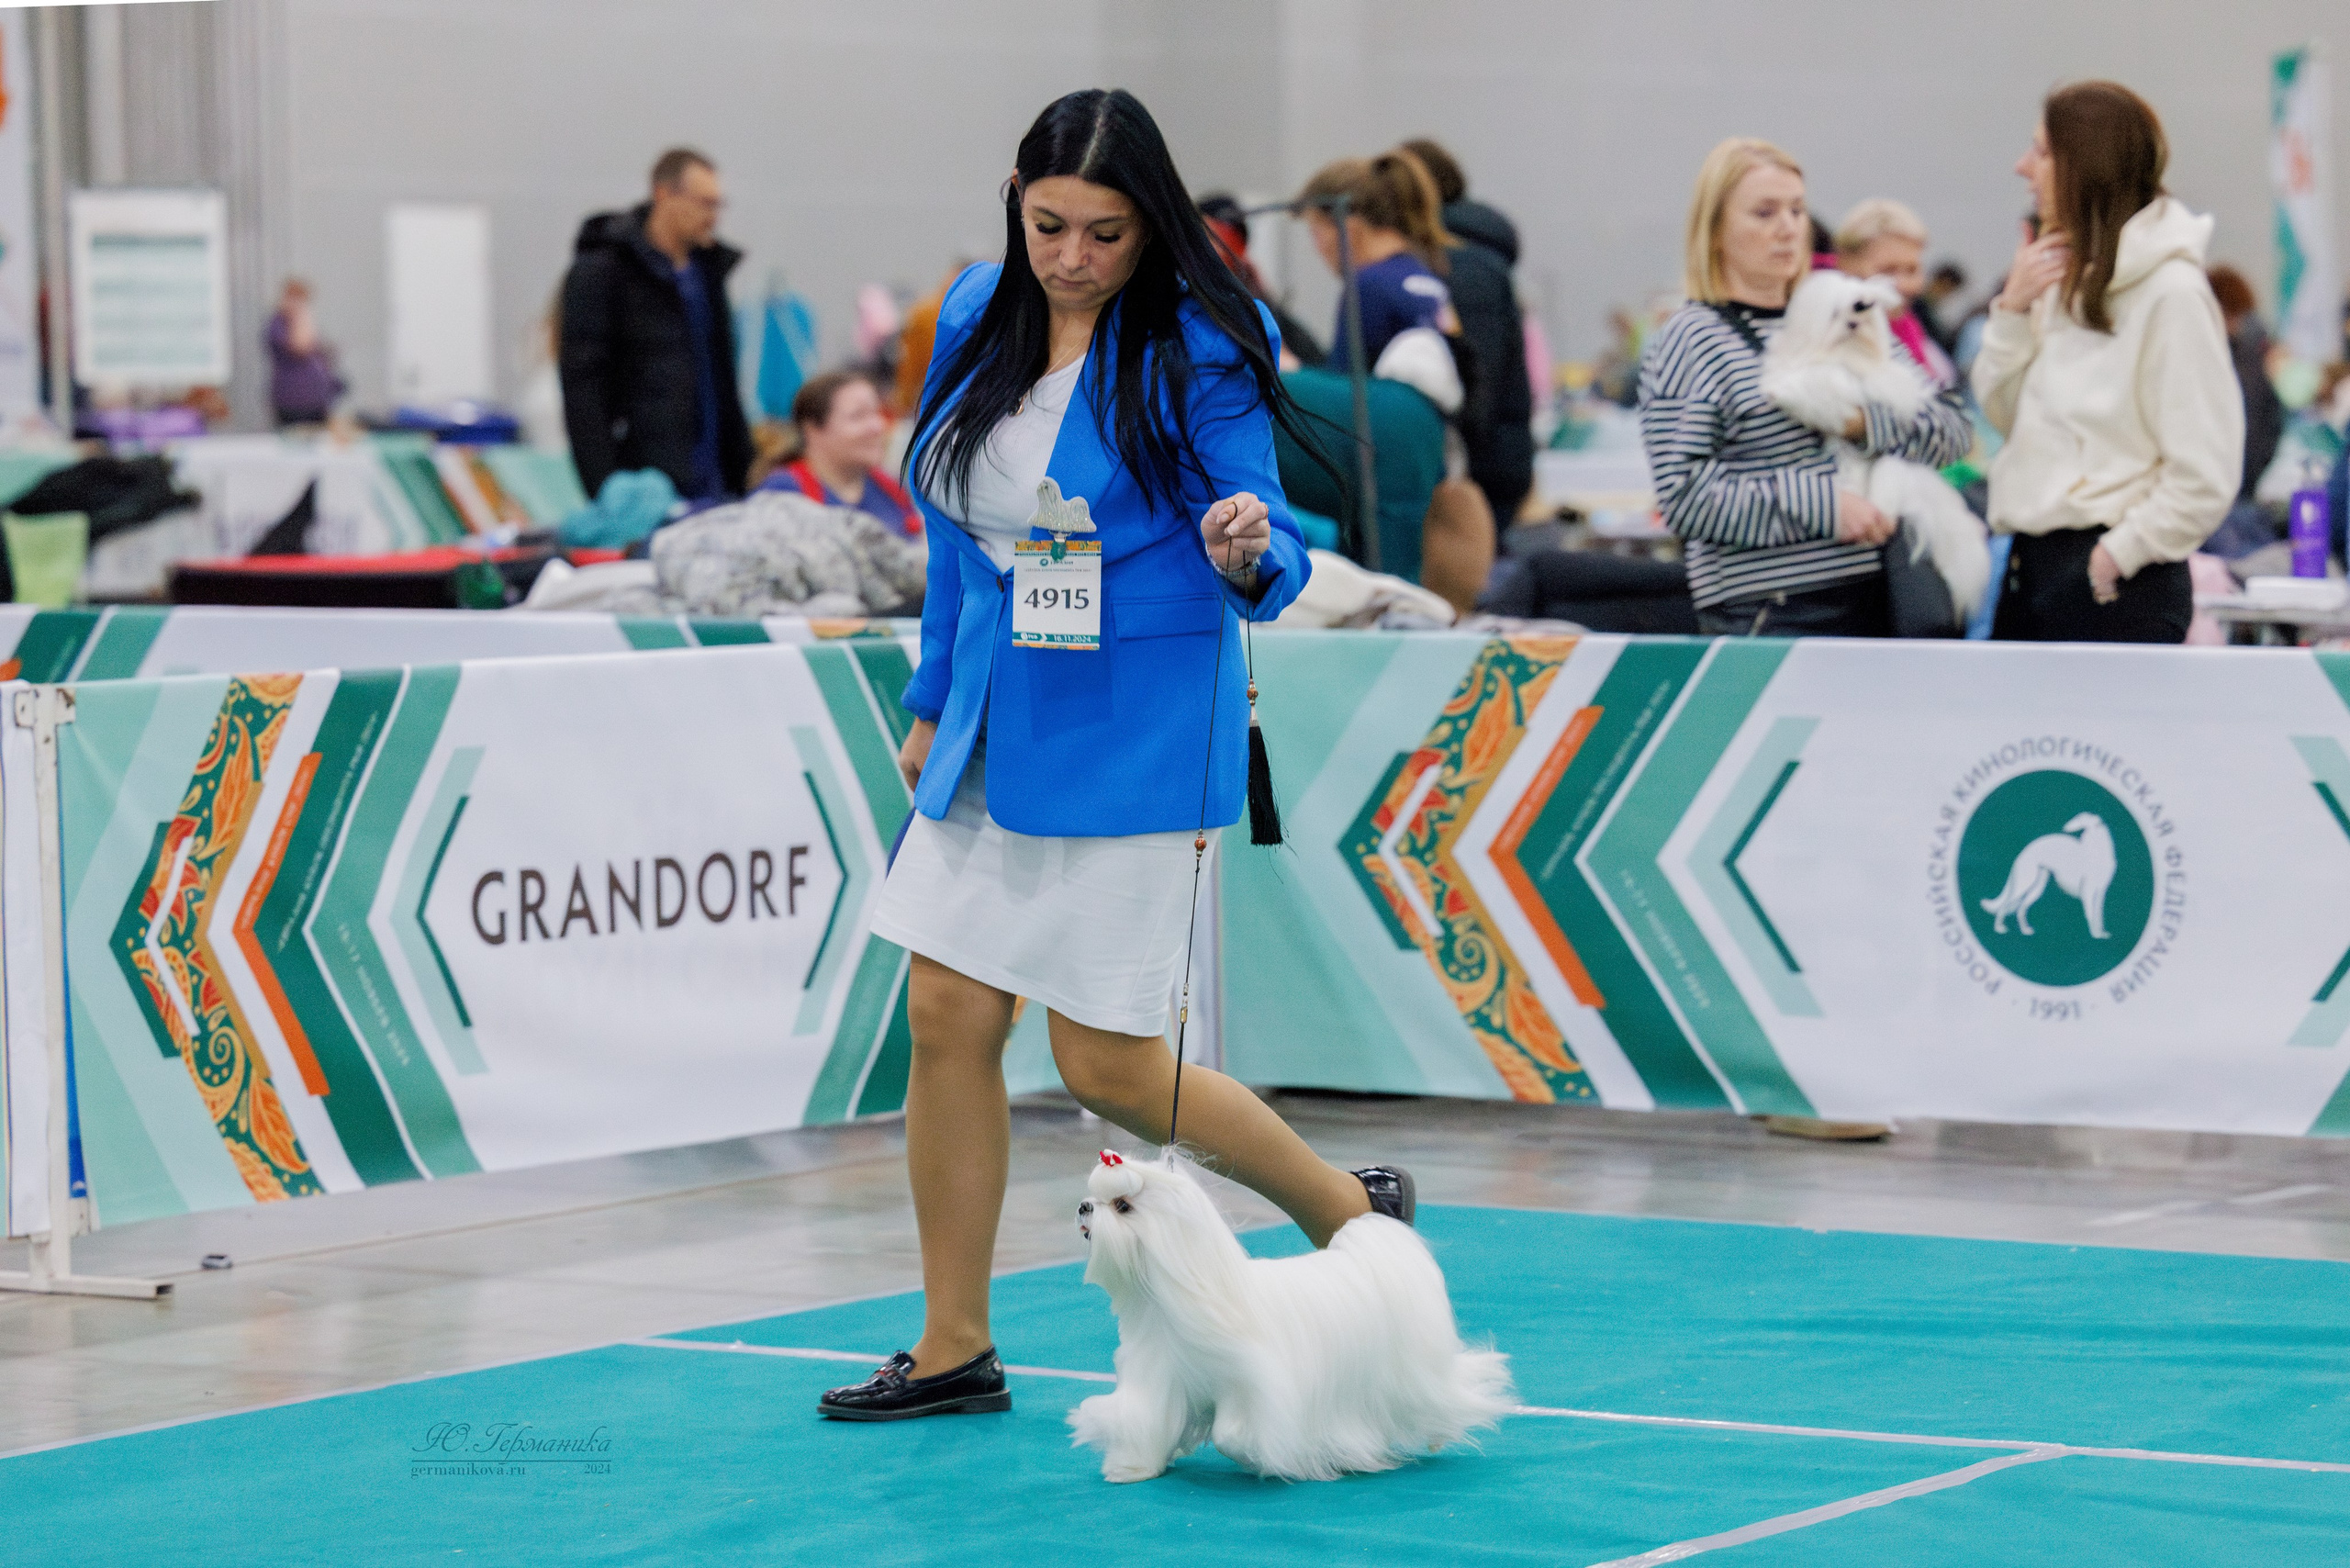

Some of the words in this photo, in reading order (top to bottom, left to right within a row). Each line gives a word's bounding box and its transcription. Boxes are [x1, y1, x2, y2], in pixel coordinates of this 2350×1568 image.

[1024, 588, 1090, 610] 4915
[1953, 735, 2175, 837] КИНОЛОГИЧЕСКАЯ
[471, 845, 810, 946] GRANDORF
[1927, 804, 2003, 995] РОССИЙСКАЯ
[2109, 846, 2187, 1002] ФЕДЕРАЦИЯ
[2030, 998, 2081, 1021] 1991
